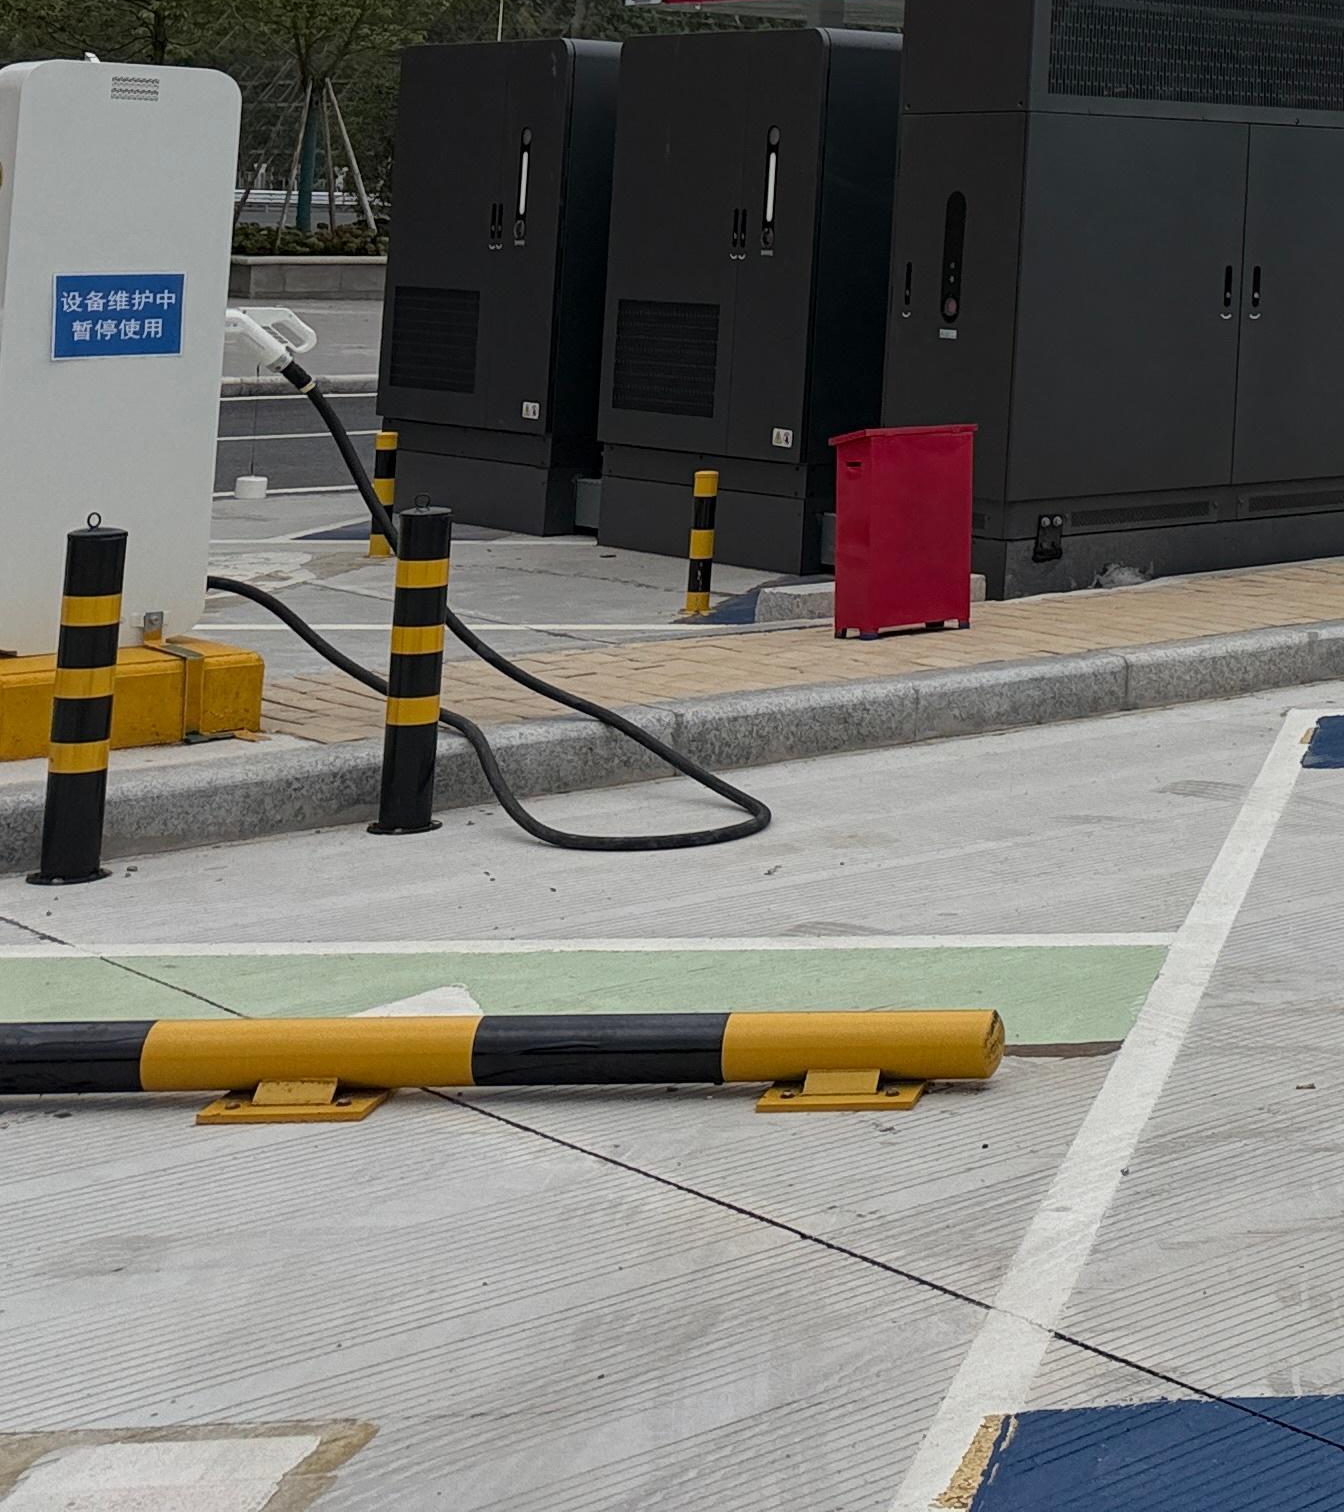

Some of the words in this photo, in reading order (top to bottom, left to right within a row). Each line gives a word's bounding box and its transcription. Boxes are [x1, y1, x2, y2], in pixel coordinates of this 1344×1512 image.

[60, 289, 176, 312] 设备维护中
[71, 318, 163, 341] 暂停使用
